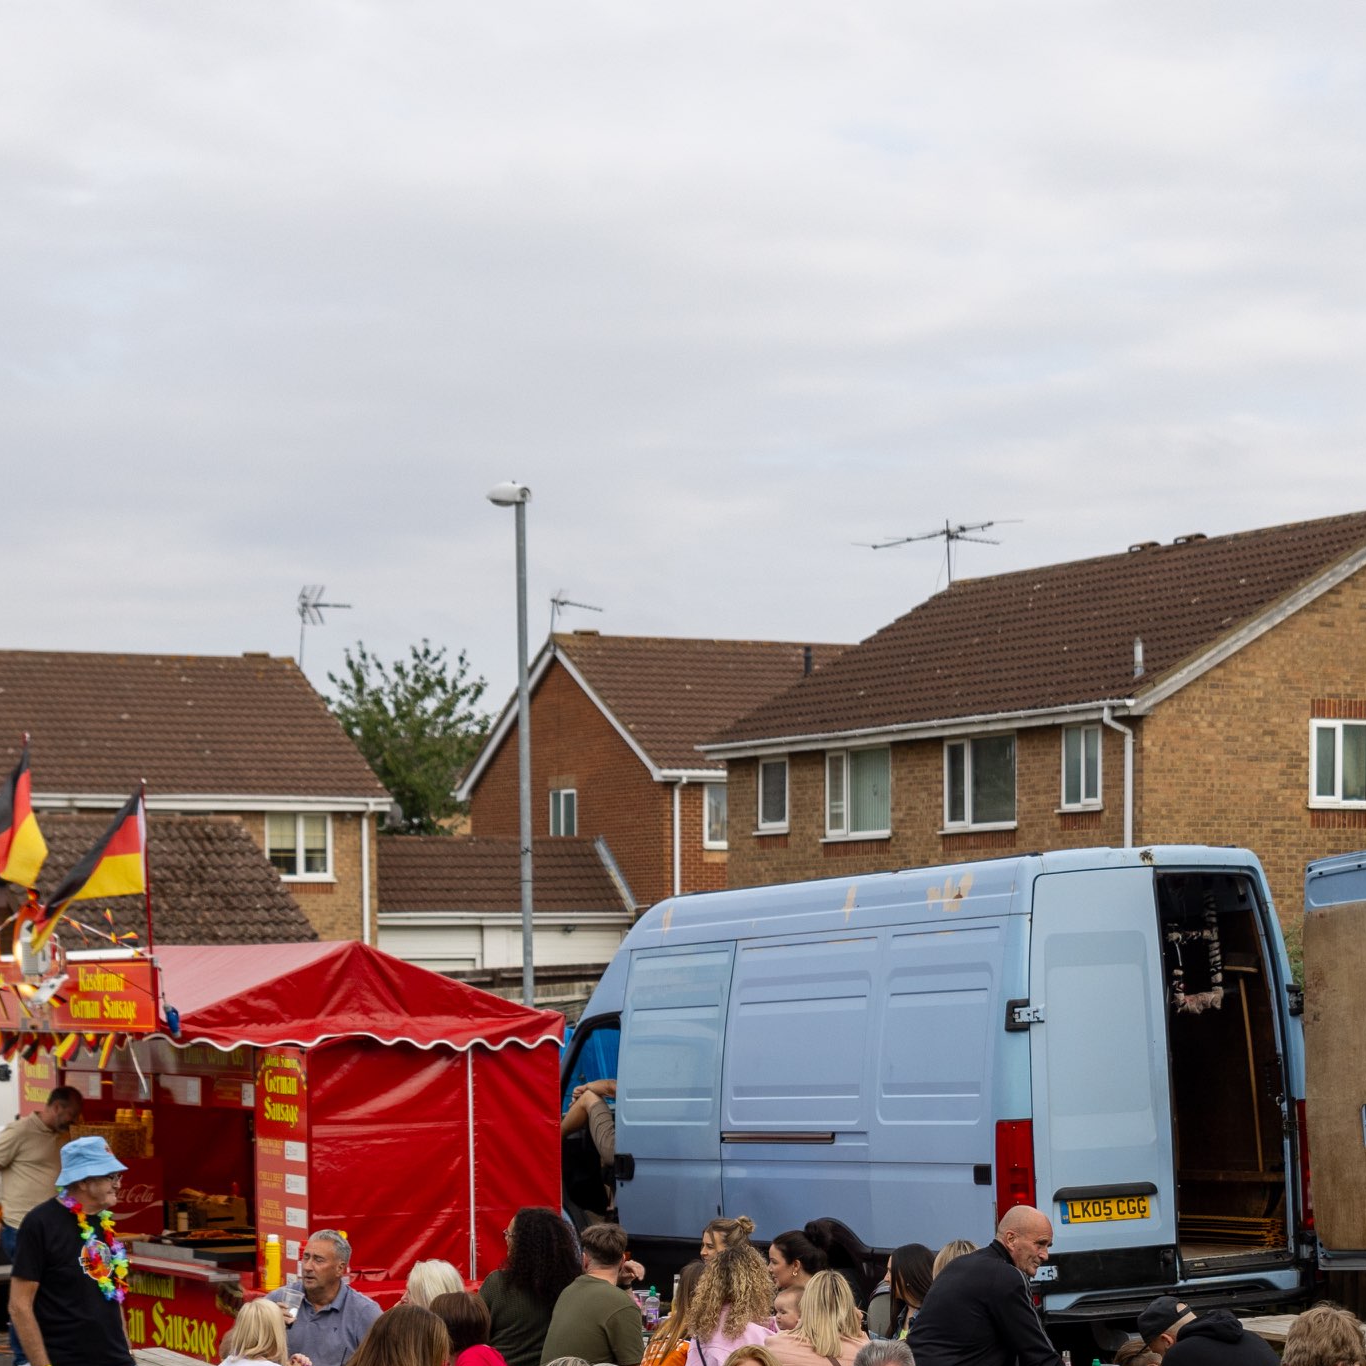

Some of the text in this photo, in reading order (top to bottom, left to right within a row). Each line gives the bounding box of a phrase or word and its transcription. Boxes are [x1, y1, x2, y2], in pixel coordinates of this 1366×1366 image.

[69, 994, 137, 1025] German Sausage
[264, 1069, 298, 1096] German
[264, 1096, 299, 1129] Sausage
[1070, 1198, 1147, 1218] LK05 CGG
[129, 1271, 175, 1300] raditional
[152, 1300, 218, 1363] Sausage
